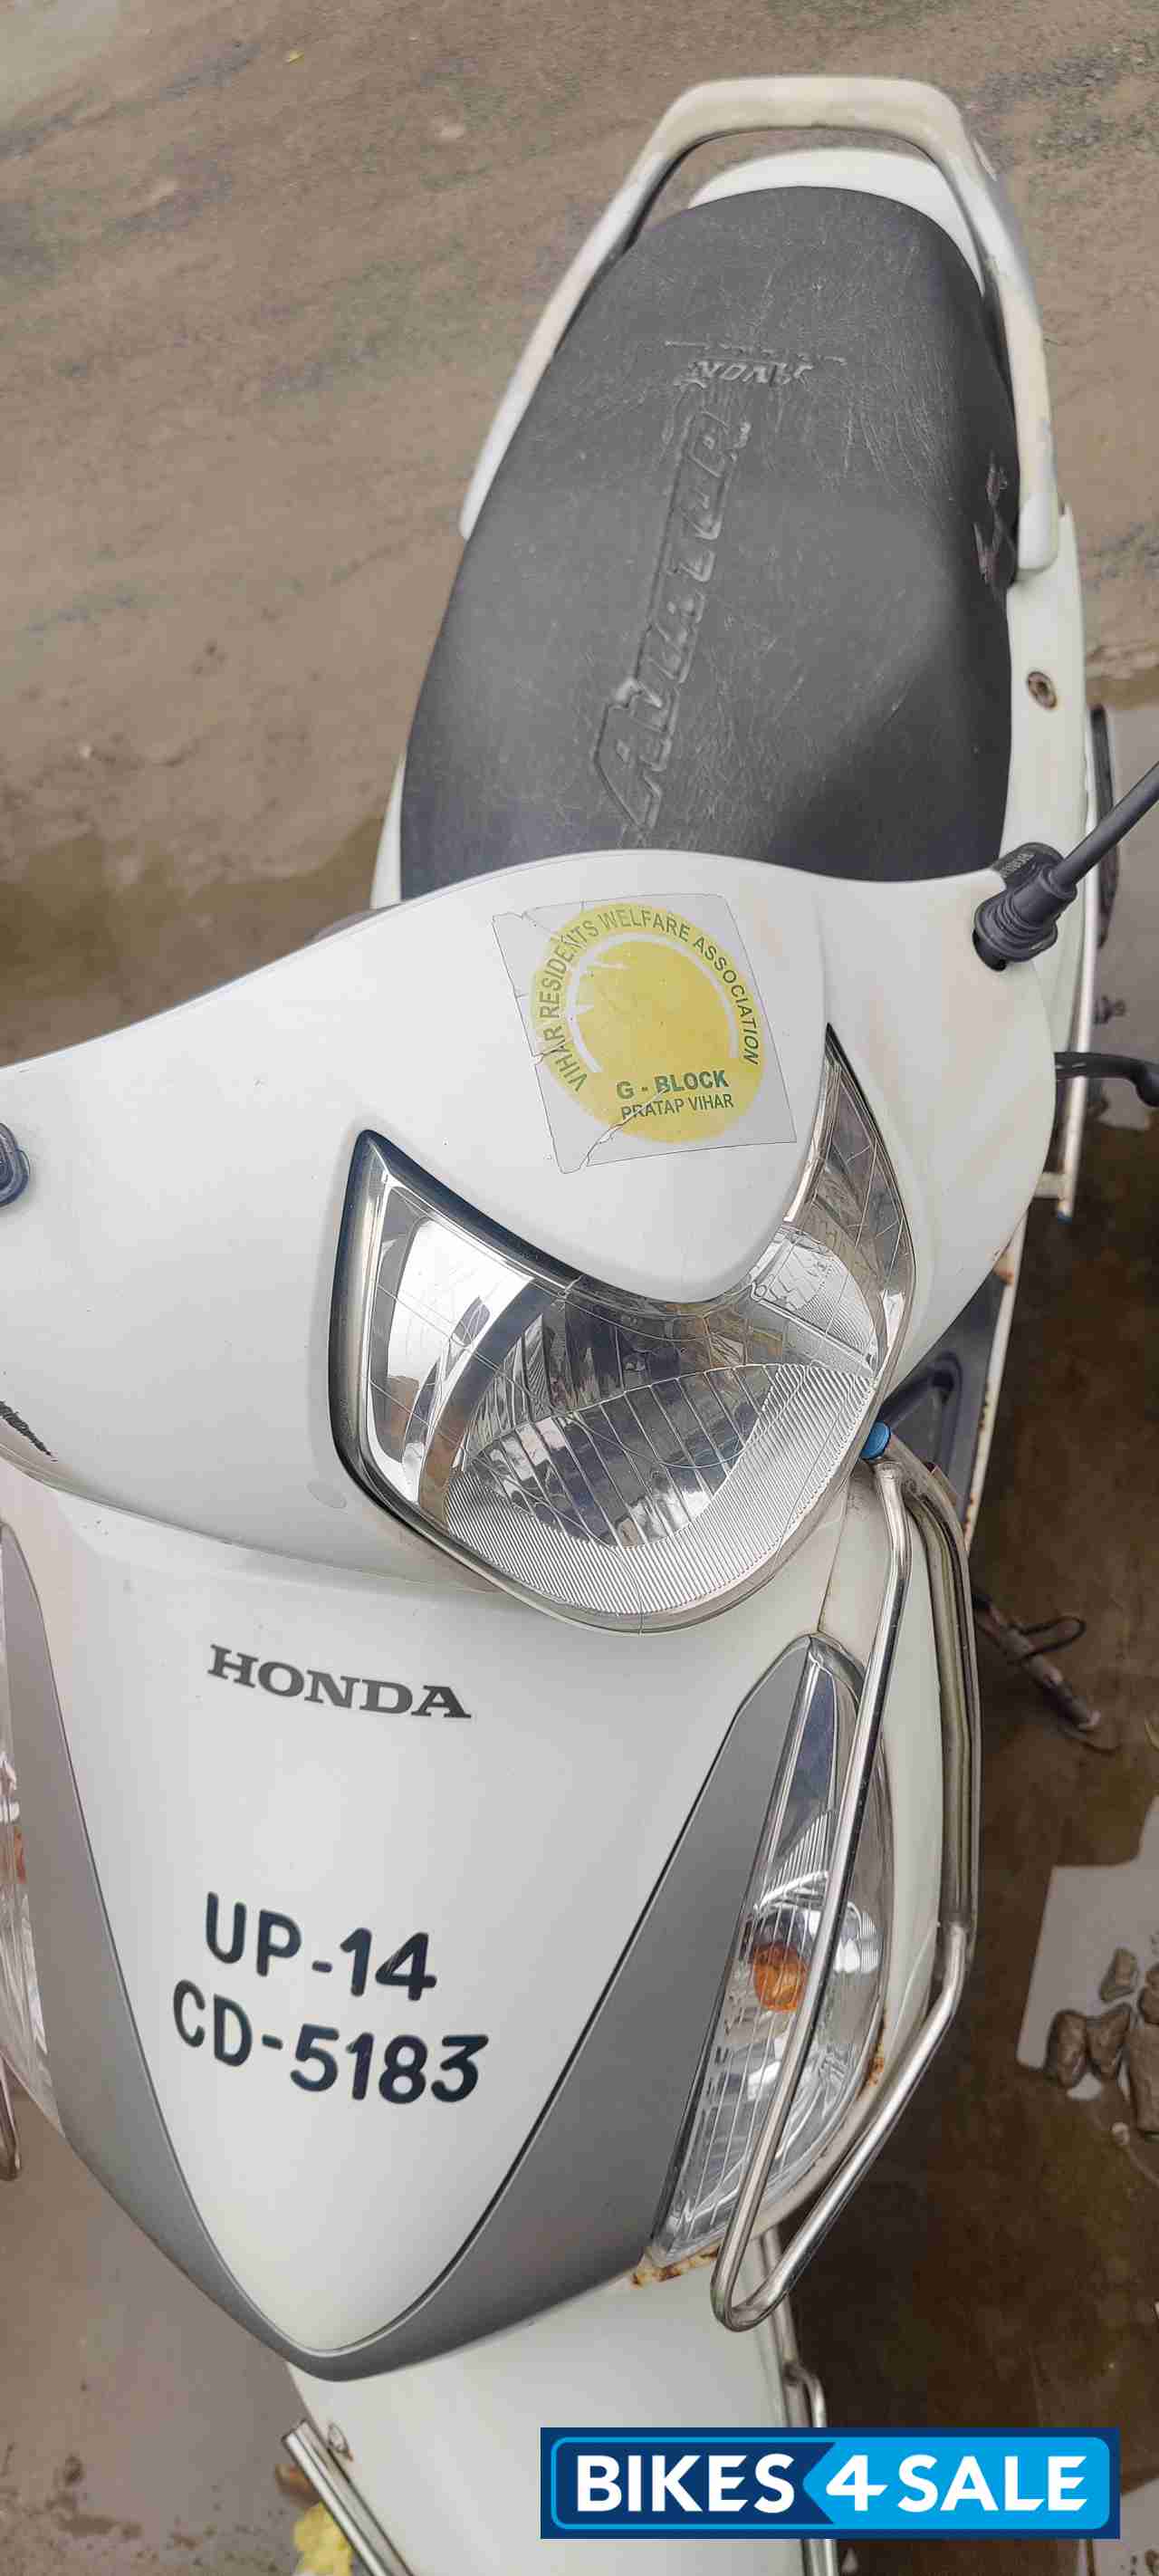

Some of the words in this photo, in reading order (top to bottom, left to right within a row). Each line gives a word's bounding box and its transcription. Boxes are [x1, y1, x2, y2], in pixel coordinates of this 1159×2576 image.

[599, 908, 690, 943] WELFARE
[539, 919, 599, 1020] RESIDENTS
[693, 937, 759, 1065] ASSOCIATION
[542, 1025, 588, 1092] VIHAR
[654, 1070, 730, 1095] BLOCK
[620, 1099, 685, 1121] PRATAP
[688, 1093, 734, 1111] VIHAR
[207, 1644, 472, 1719] HONDA
[206, 1891, 437, 2002] UP-14
[173, 1979, 489, 2104] CD-5183
